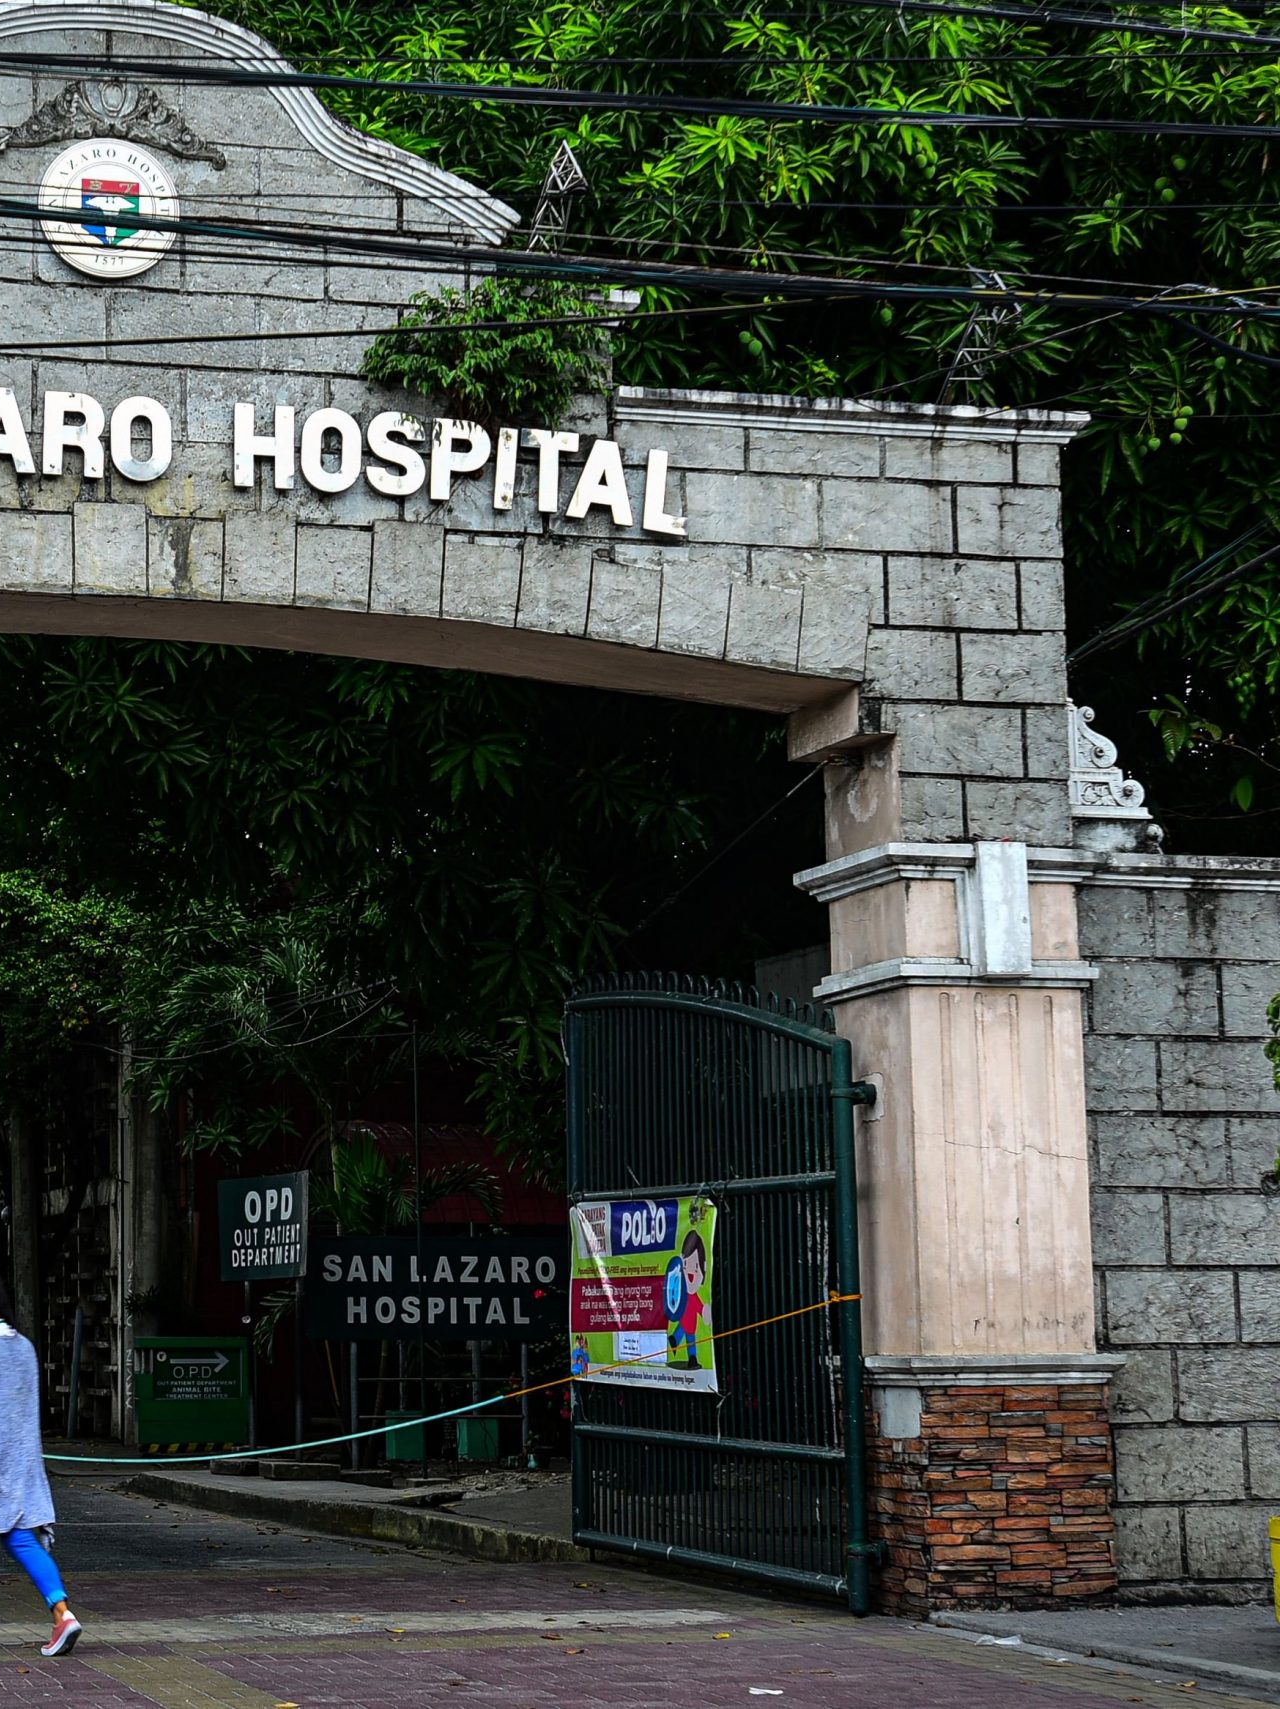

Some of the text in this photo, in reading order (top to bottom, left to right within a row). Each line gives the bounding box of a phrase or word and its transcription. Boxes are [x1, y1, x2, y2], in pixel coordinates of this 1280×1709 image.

[233, 402, 687, 536] HOSPITAL
[245, 1187, 293, 1223] OPD
[234, 1223, 300, 1247] OUT PATIENT
[621, 1207, 666, 1248] POLIO
[231, 1244, 300, 1267] DEPARTMENT
[322, 1254, 556, 1284] SAN LAZARO
[347, 1296, 530, 1325] HOSPITAL
